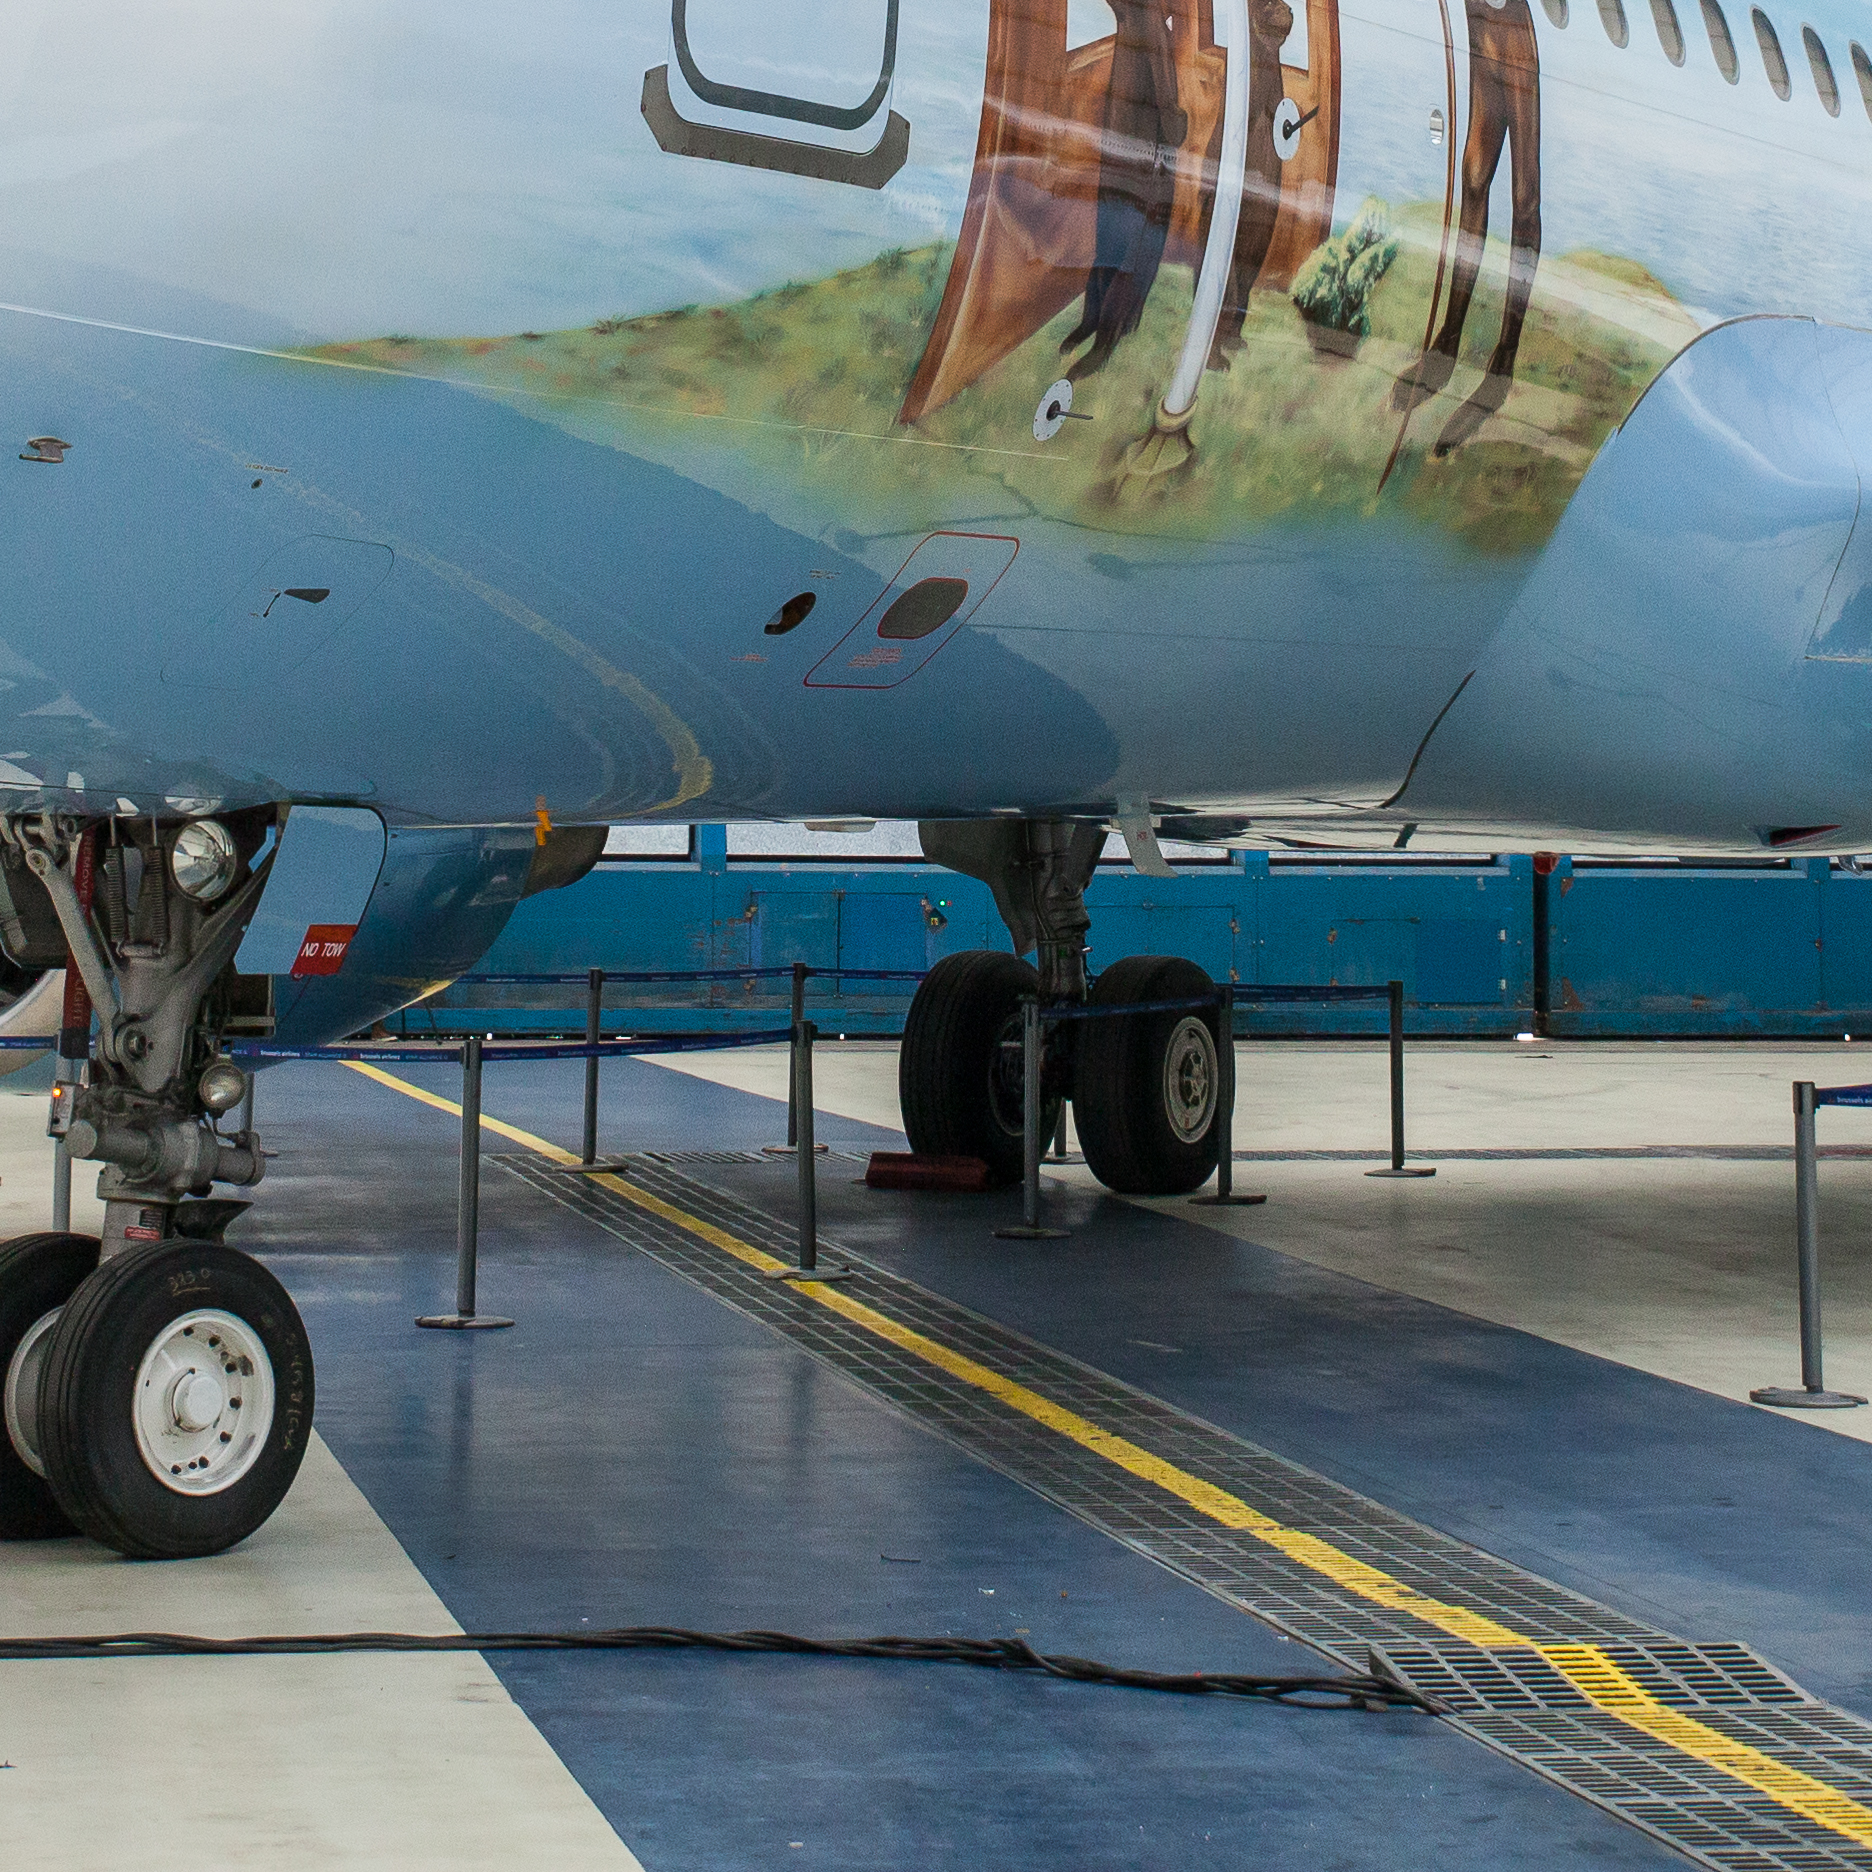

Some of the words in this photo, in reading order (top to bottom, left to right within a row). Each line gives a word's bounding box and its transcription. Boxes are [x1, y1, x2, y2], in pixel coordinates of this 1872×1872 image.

[81, 835, 93, 900] REMOVE
[300, 942, 320, 958] NO
[321, 942, 347, 958] TOW
